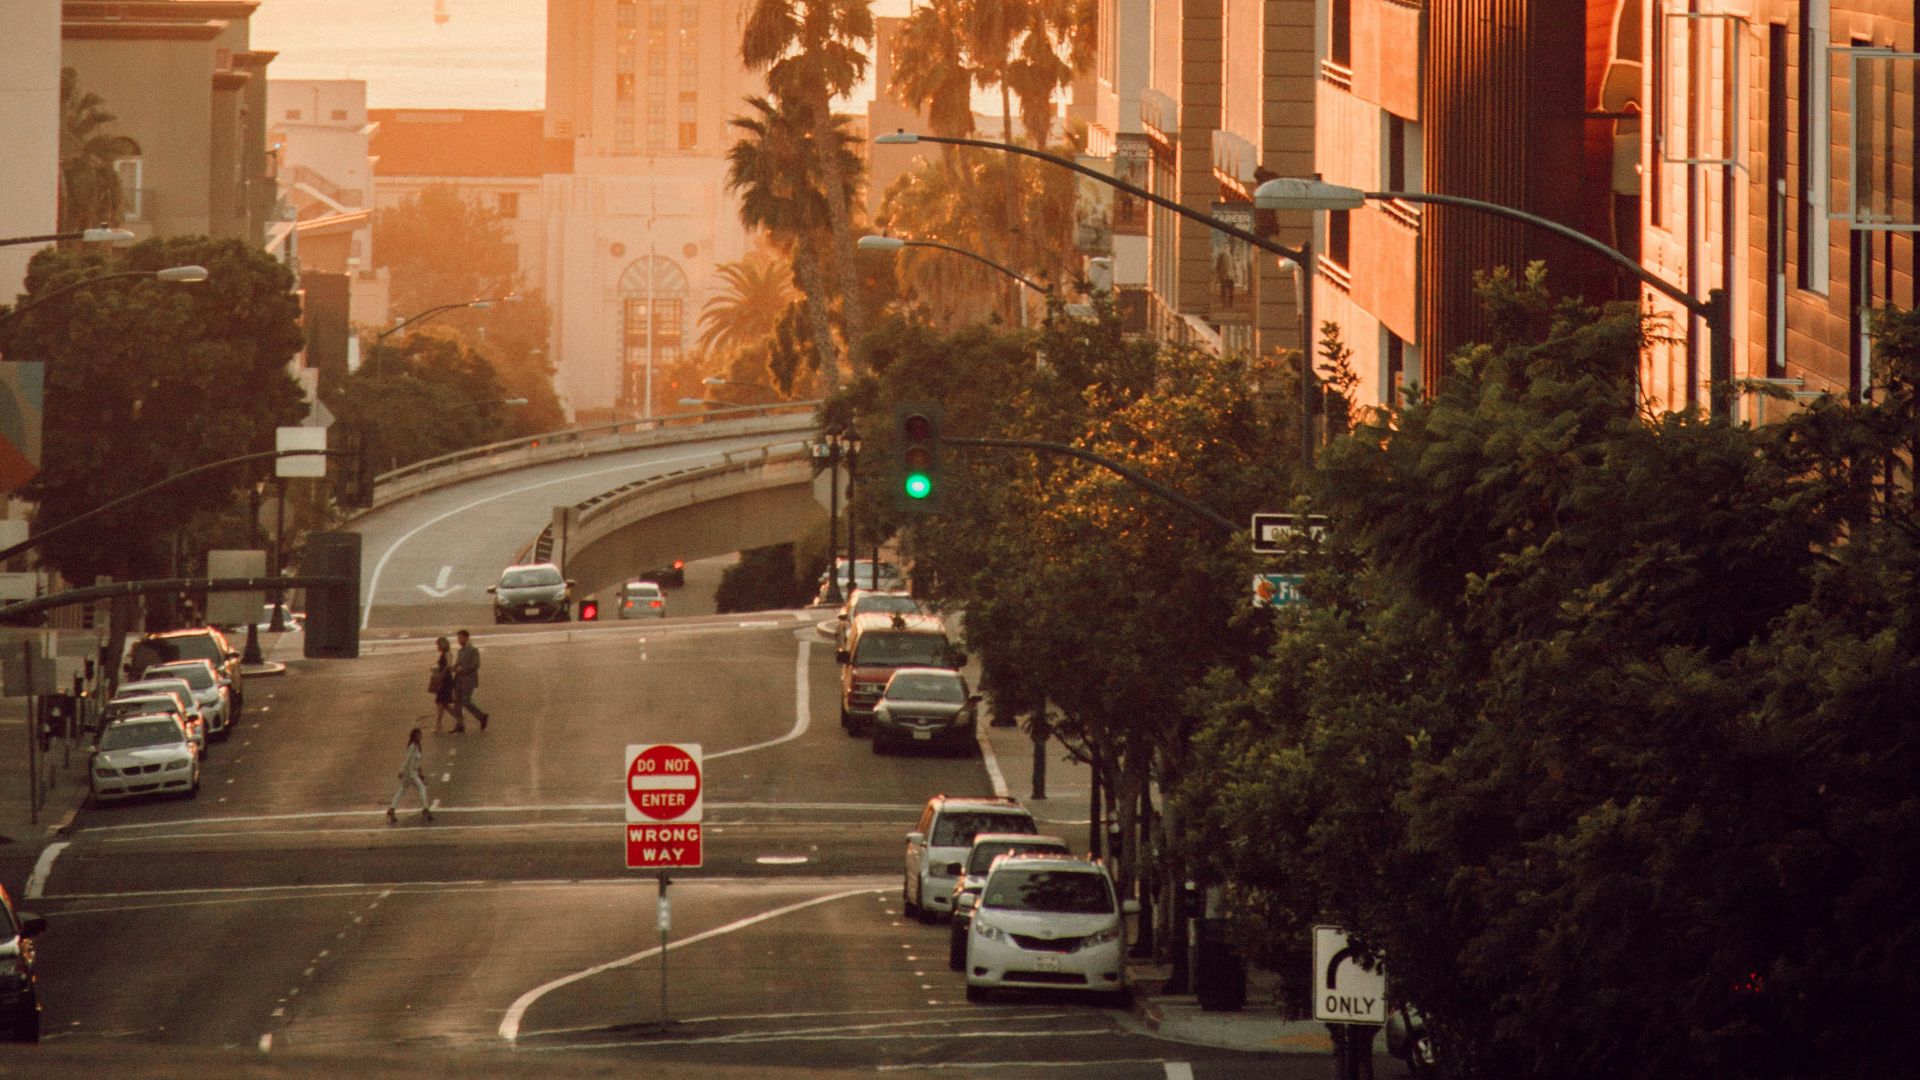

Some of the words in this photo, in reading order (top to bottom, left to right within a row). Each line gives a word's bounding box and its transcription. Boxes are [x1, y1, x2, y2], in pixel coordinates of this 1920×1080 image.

[637, 759, 656, 772] DO
[665, 759, 691, 772] NOT
[642, 794, 686, 807] ENTER
[629, 829, 699, 842] WRONG
[643, 848, 685, 861] WAY
[1326, 995, 1376, 1015] ONLY
